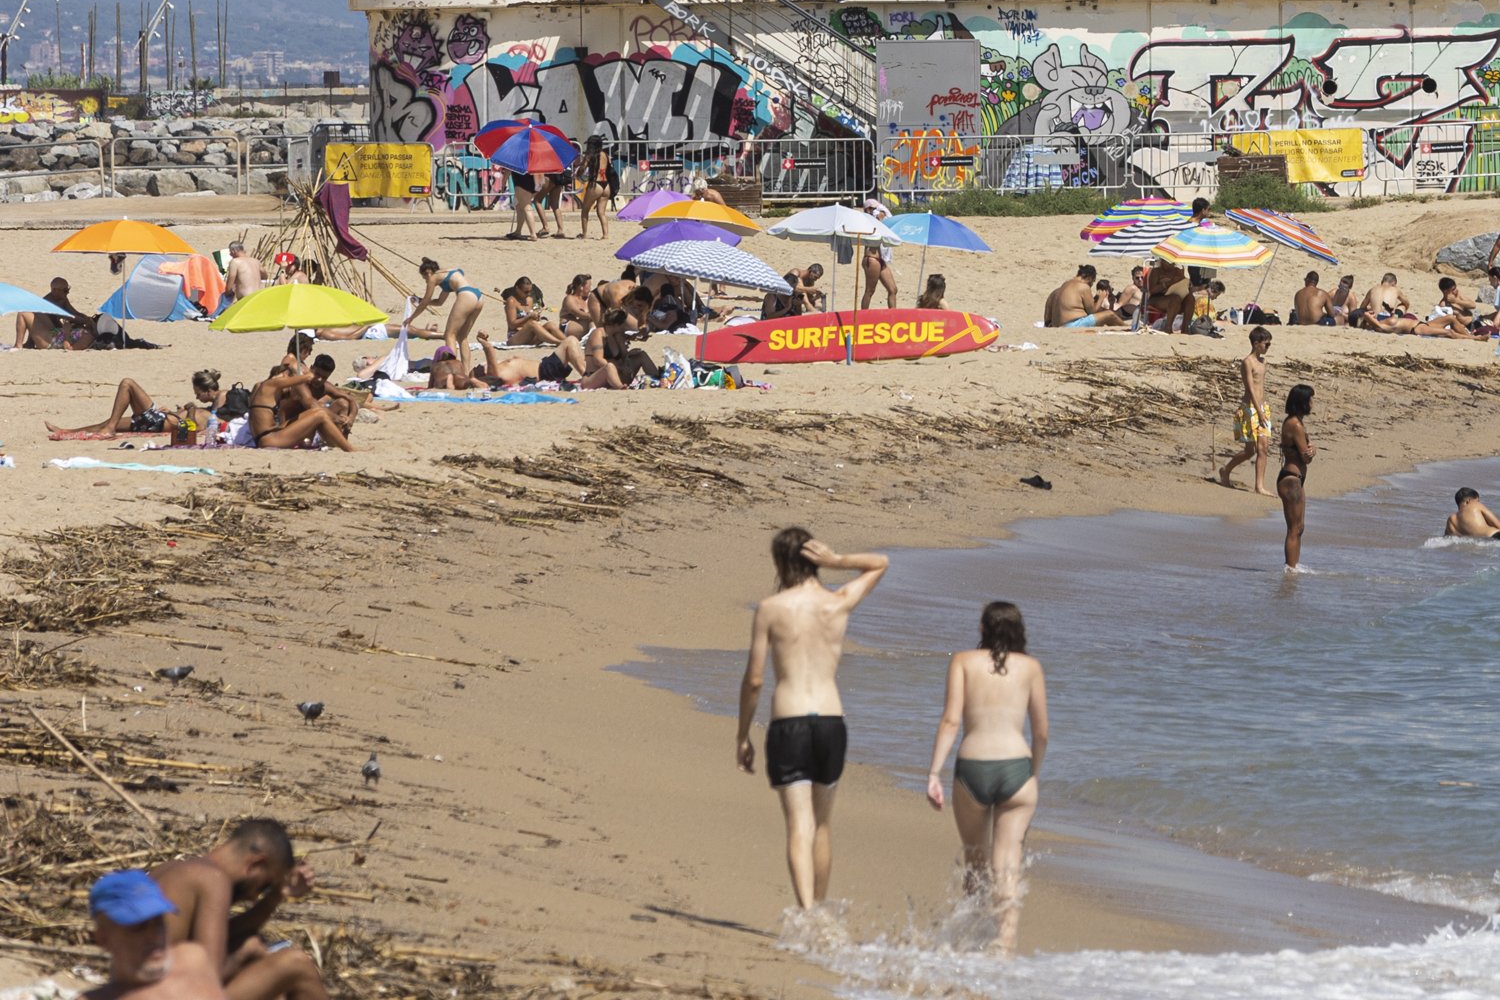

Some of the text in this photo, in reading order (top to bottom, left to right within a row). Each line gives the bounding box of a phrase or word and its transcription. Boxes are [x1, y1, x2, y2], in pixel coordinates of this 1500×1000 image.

[1314, 138, 1342, 146] PASSAR
[768, 321, 945, 351] SURF RESCUE
